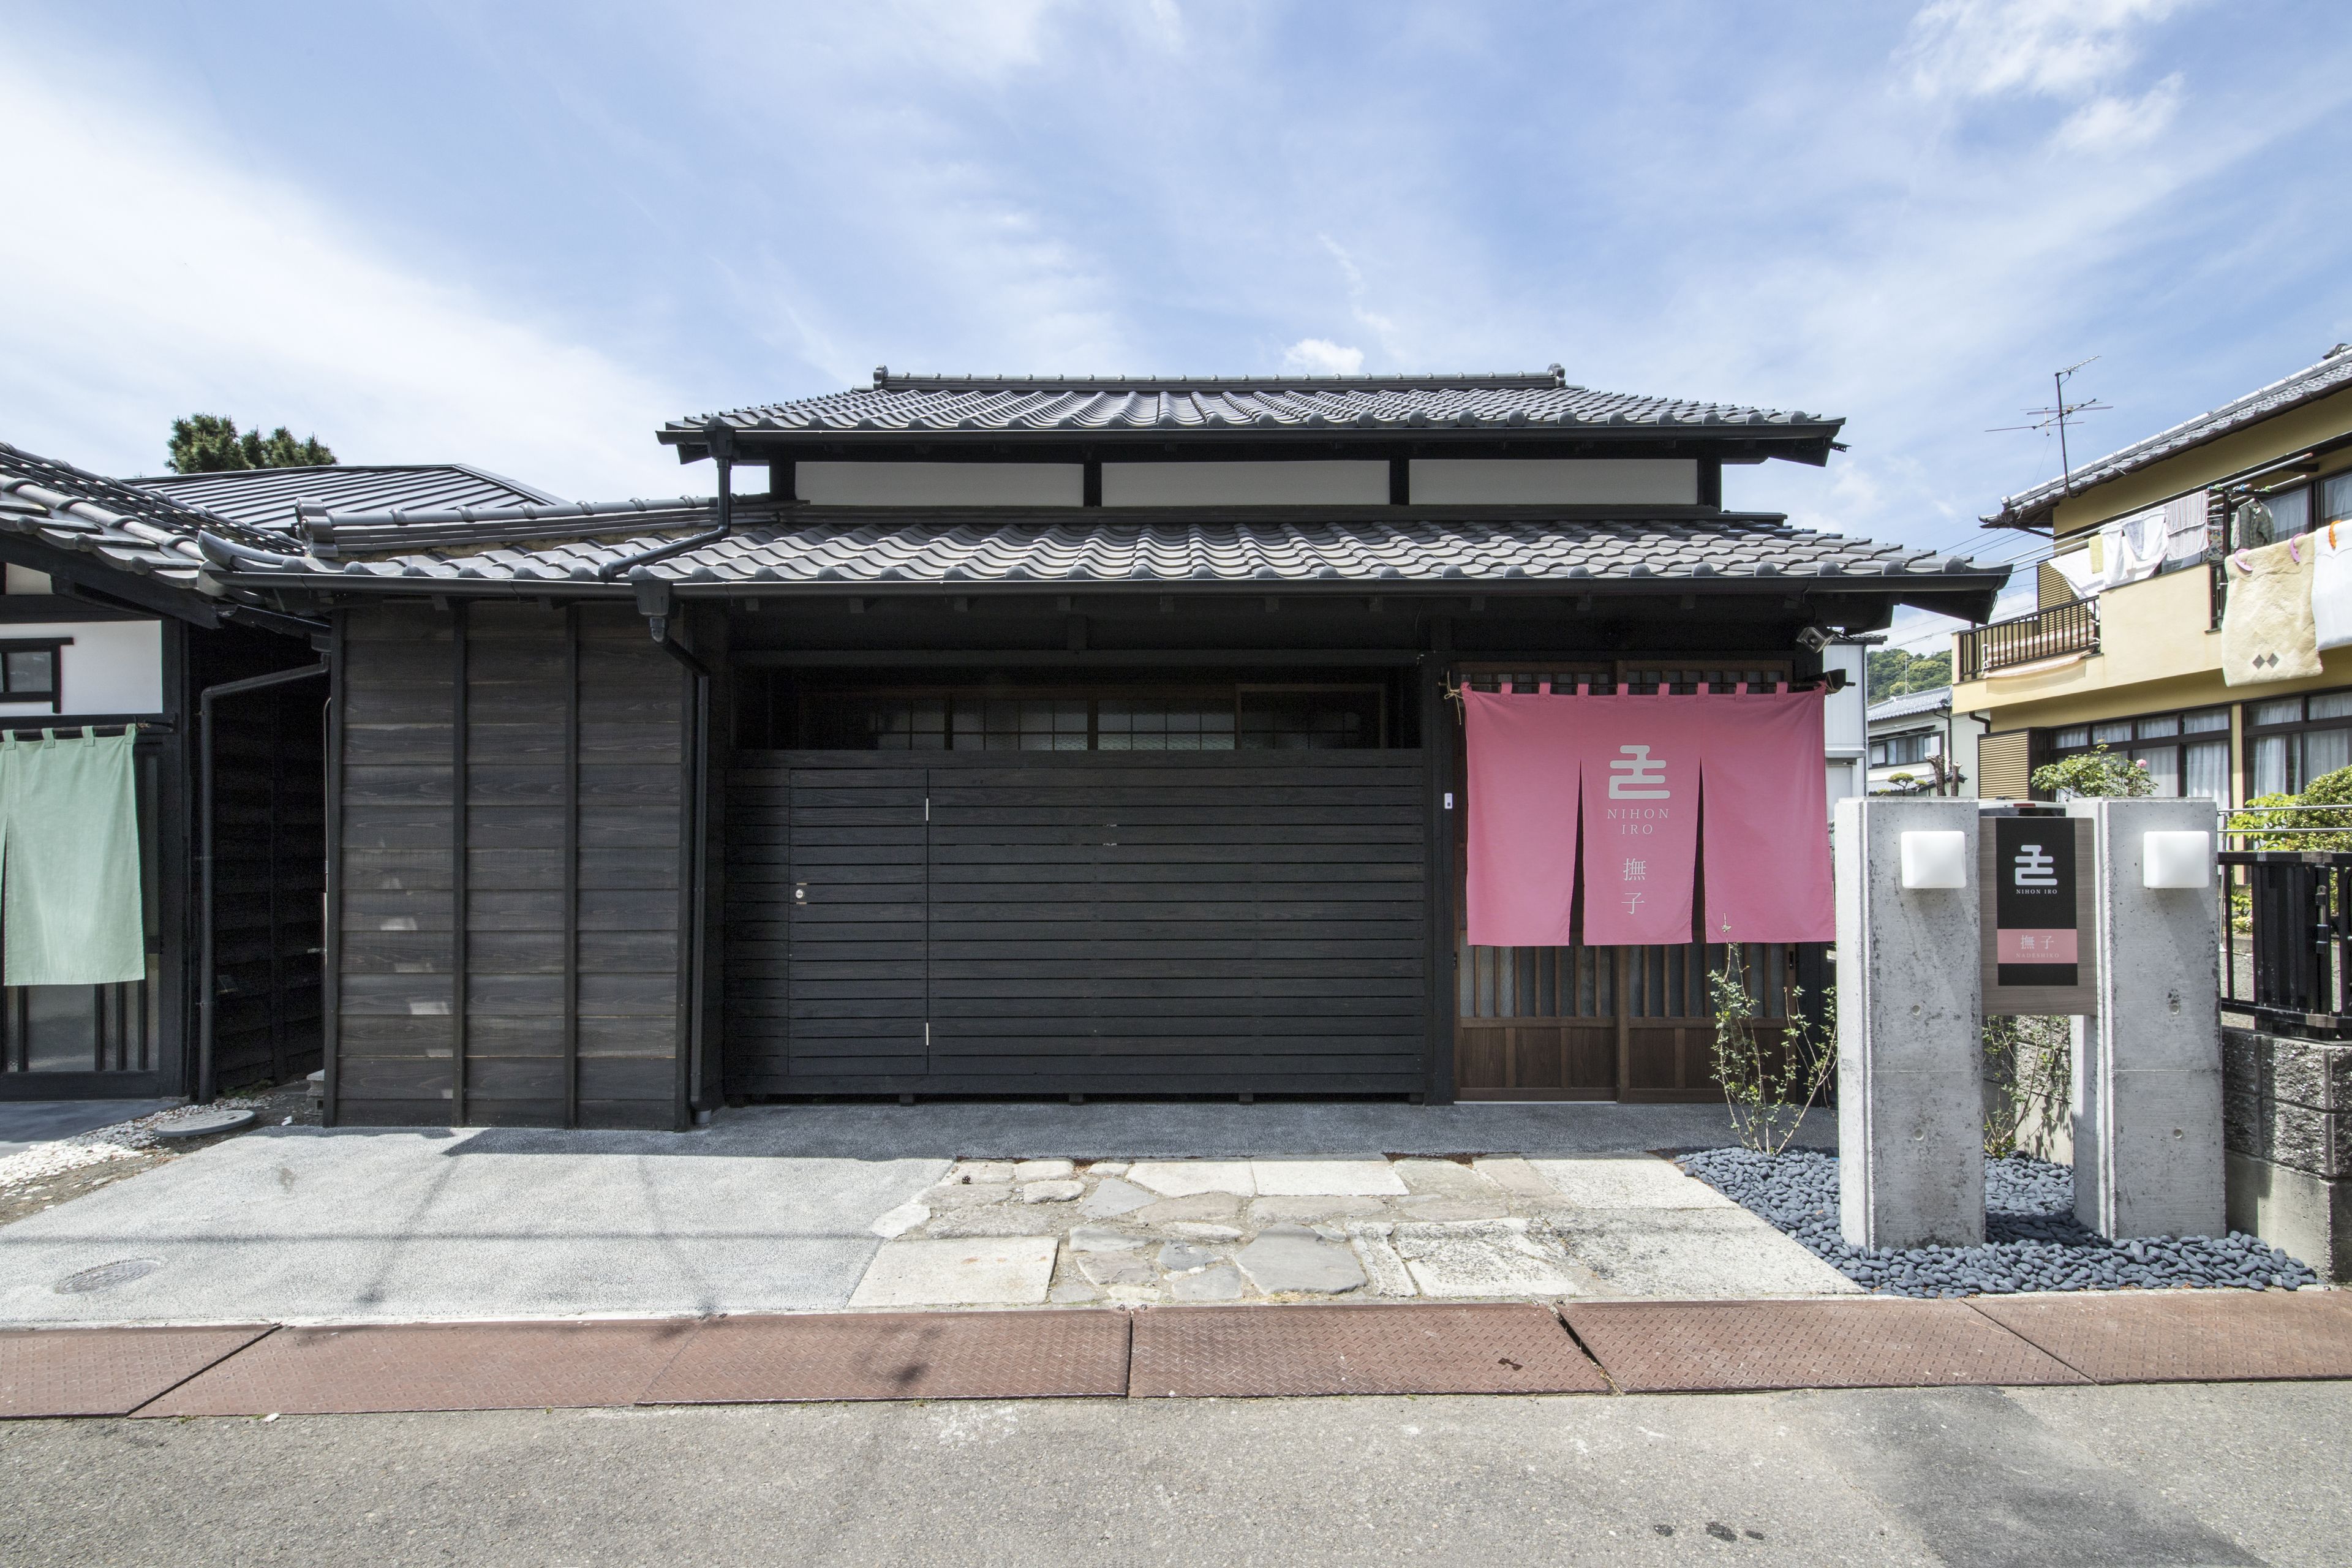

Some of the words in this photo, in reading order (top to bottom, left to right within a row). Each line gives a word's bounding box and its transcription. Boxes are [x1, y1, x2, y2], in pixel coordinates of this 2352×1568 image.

[1607, 809, 1670, 819] NIHON
[1621, 824, 1653, 835] IRO
[1621, 858, 1647, 915] 撫子
[2020, 935, 2054, 950] 撫子
